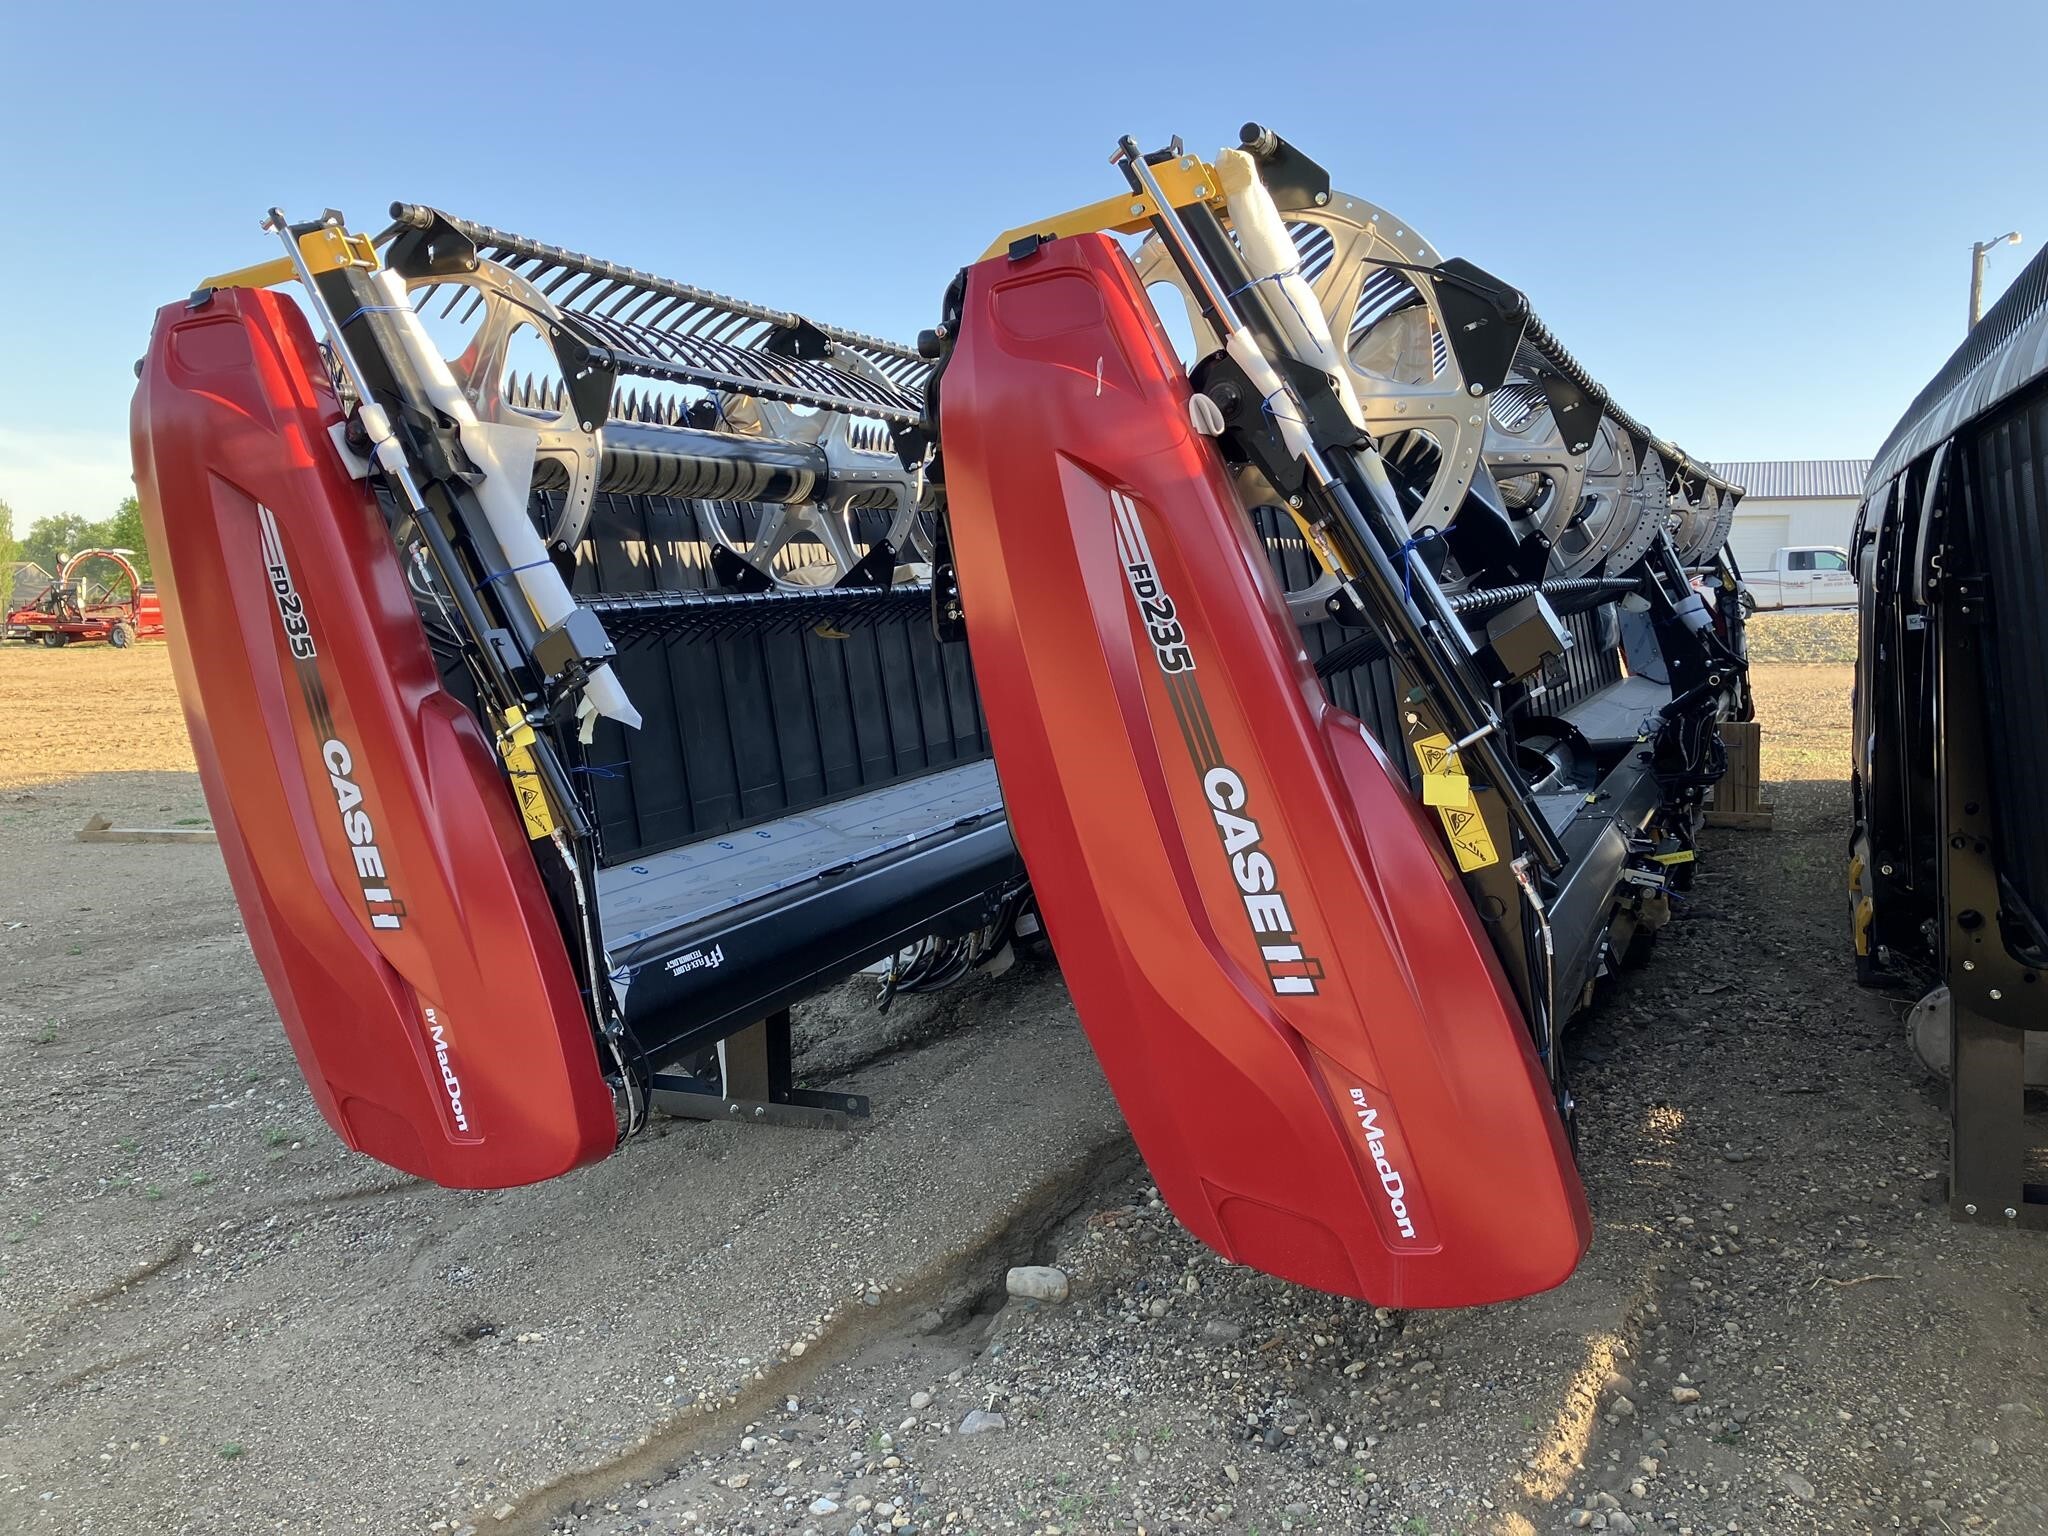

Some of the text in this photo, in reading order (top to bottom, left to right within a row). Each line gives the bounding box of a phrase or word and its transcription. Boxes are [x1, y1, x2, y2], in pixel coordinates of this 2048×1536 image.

[270, 565, 317, 659] FD235
[1128, 563, 1196, 674] FD235
[322, 739, 386, 878] CASE
[1203, 767, 1293, 933] CASE
[425, 1008, 468, 1132] BY MacDon
[1349, 1088, 1416, 1239] BY MacDon
